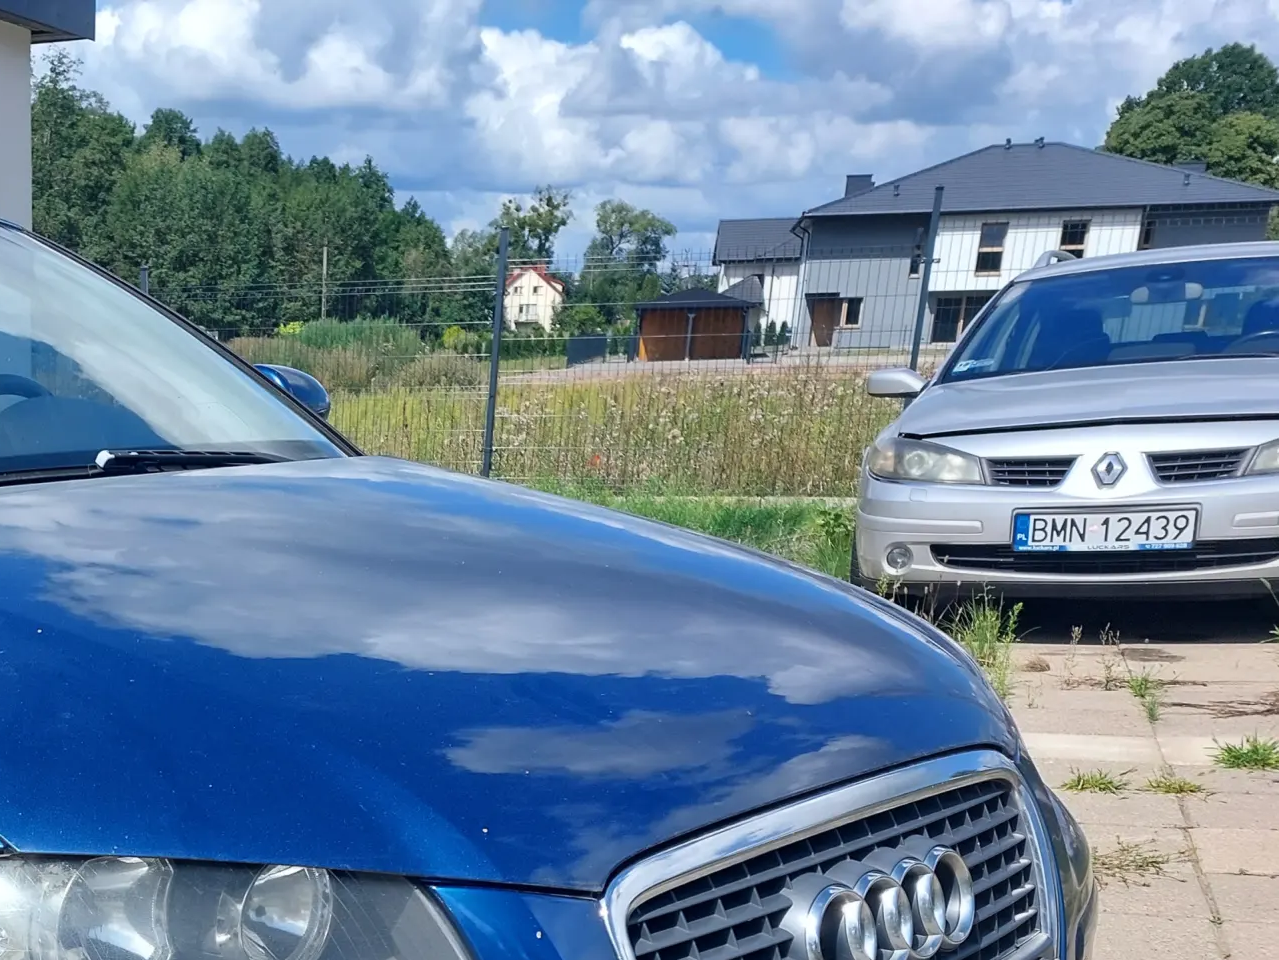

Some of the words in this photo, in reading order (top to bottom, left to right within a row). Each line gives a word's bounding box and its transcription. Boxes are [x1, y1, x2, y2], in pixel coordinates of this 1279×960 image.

[1016, 533, 1027, 541] PL
[1031, 517, 1087, 543] BMN
[1100, 514, 1190, 542] 12439
